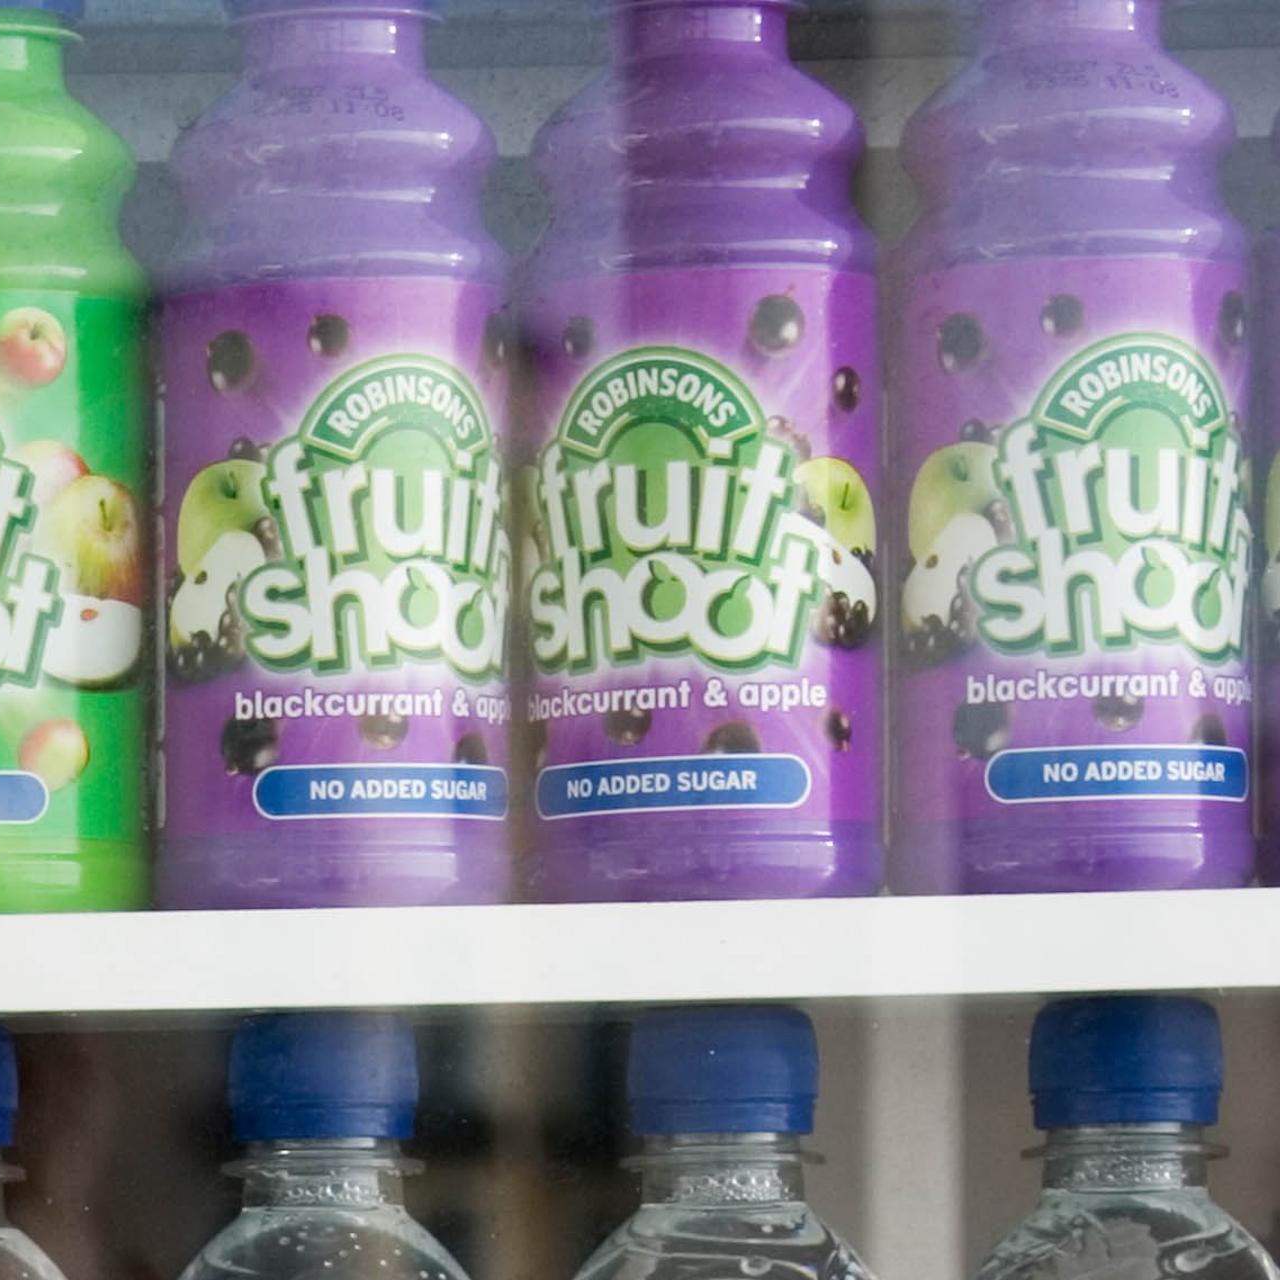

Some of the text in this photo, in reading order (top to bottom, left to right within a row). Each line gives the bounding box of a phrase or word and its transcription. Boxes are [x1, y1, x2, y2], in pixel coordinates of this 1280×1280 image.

[327, 374, 476, 439] ROBINSONS
[577, 367, 736, 435] ROBINSONS
[1060, 353, 1211, 418] ROBINSONS
[543, 441, 785, 560] fruit
[1001, 424, 1238, 550] fruit
[533, 537, 812, 662] shoot
[235, 689, 470, 719] blackcurrant &
[703, 680, 727, 707] &
[739, 680, 826, 712] apple
[966, 669, 1206, 703] blackcurrant &
[567, 771, 756, 799] NO ADDED SUGAR
